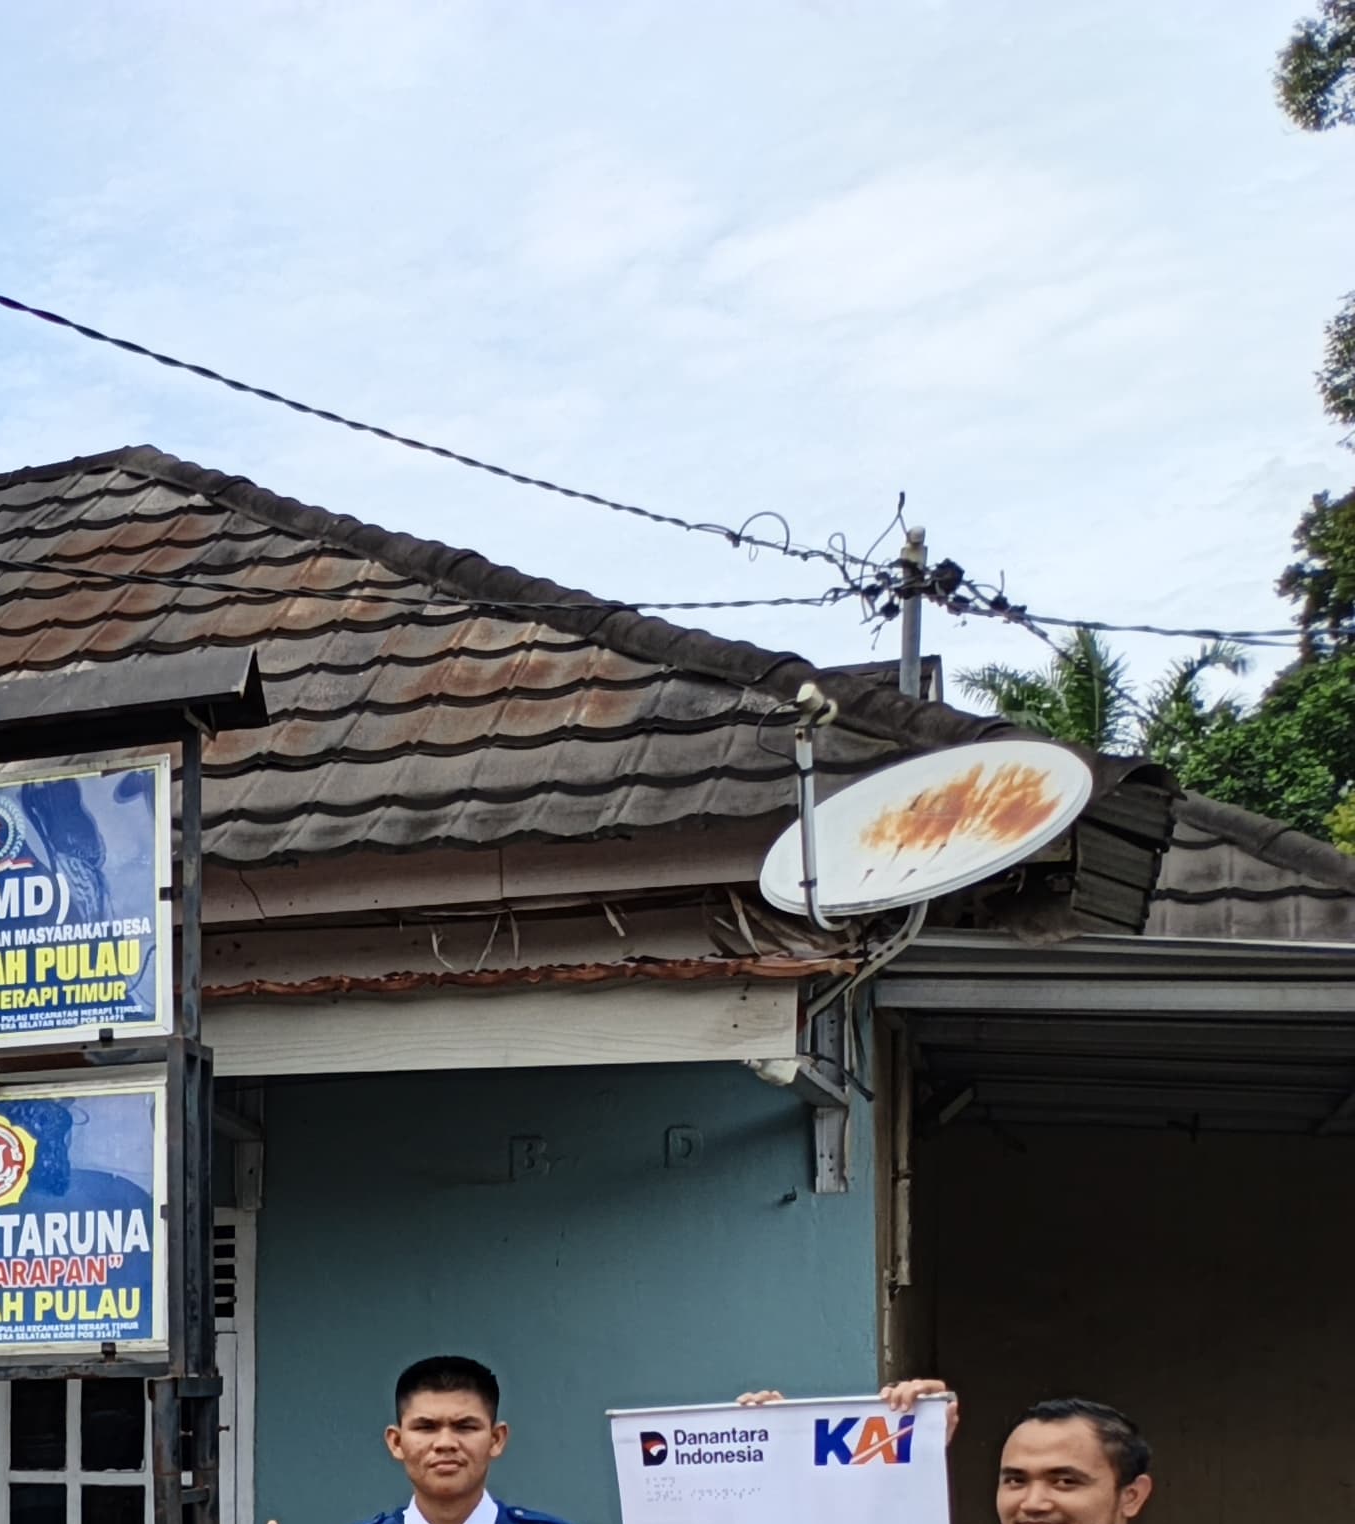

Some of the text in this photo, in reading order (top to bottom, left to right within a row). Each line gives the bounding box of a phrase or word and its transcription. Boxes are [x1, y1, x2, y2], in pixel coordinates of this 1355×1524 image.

[15, 921, 110, 947] MASYARAKAT
[112, 917, 151, 938] DESA
[34, 1287, 141, 1322] PULAU
[673, 1428, 769, 1446] Danantara
[814, 1414, 916, 1466] KAI
[674, 1446, 764, 1465] Indonesia
